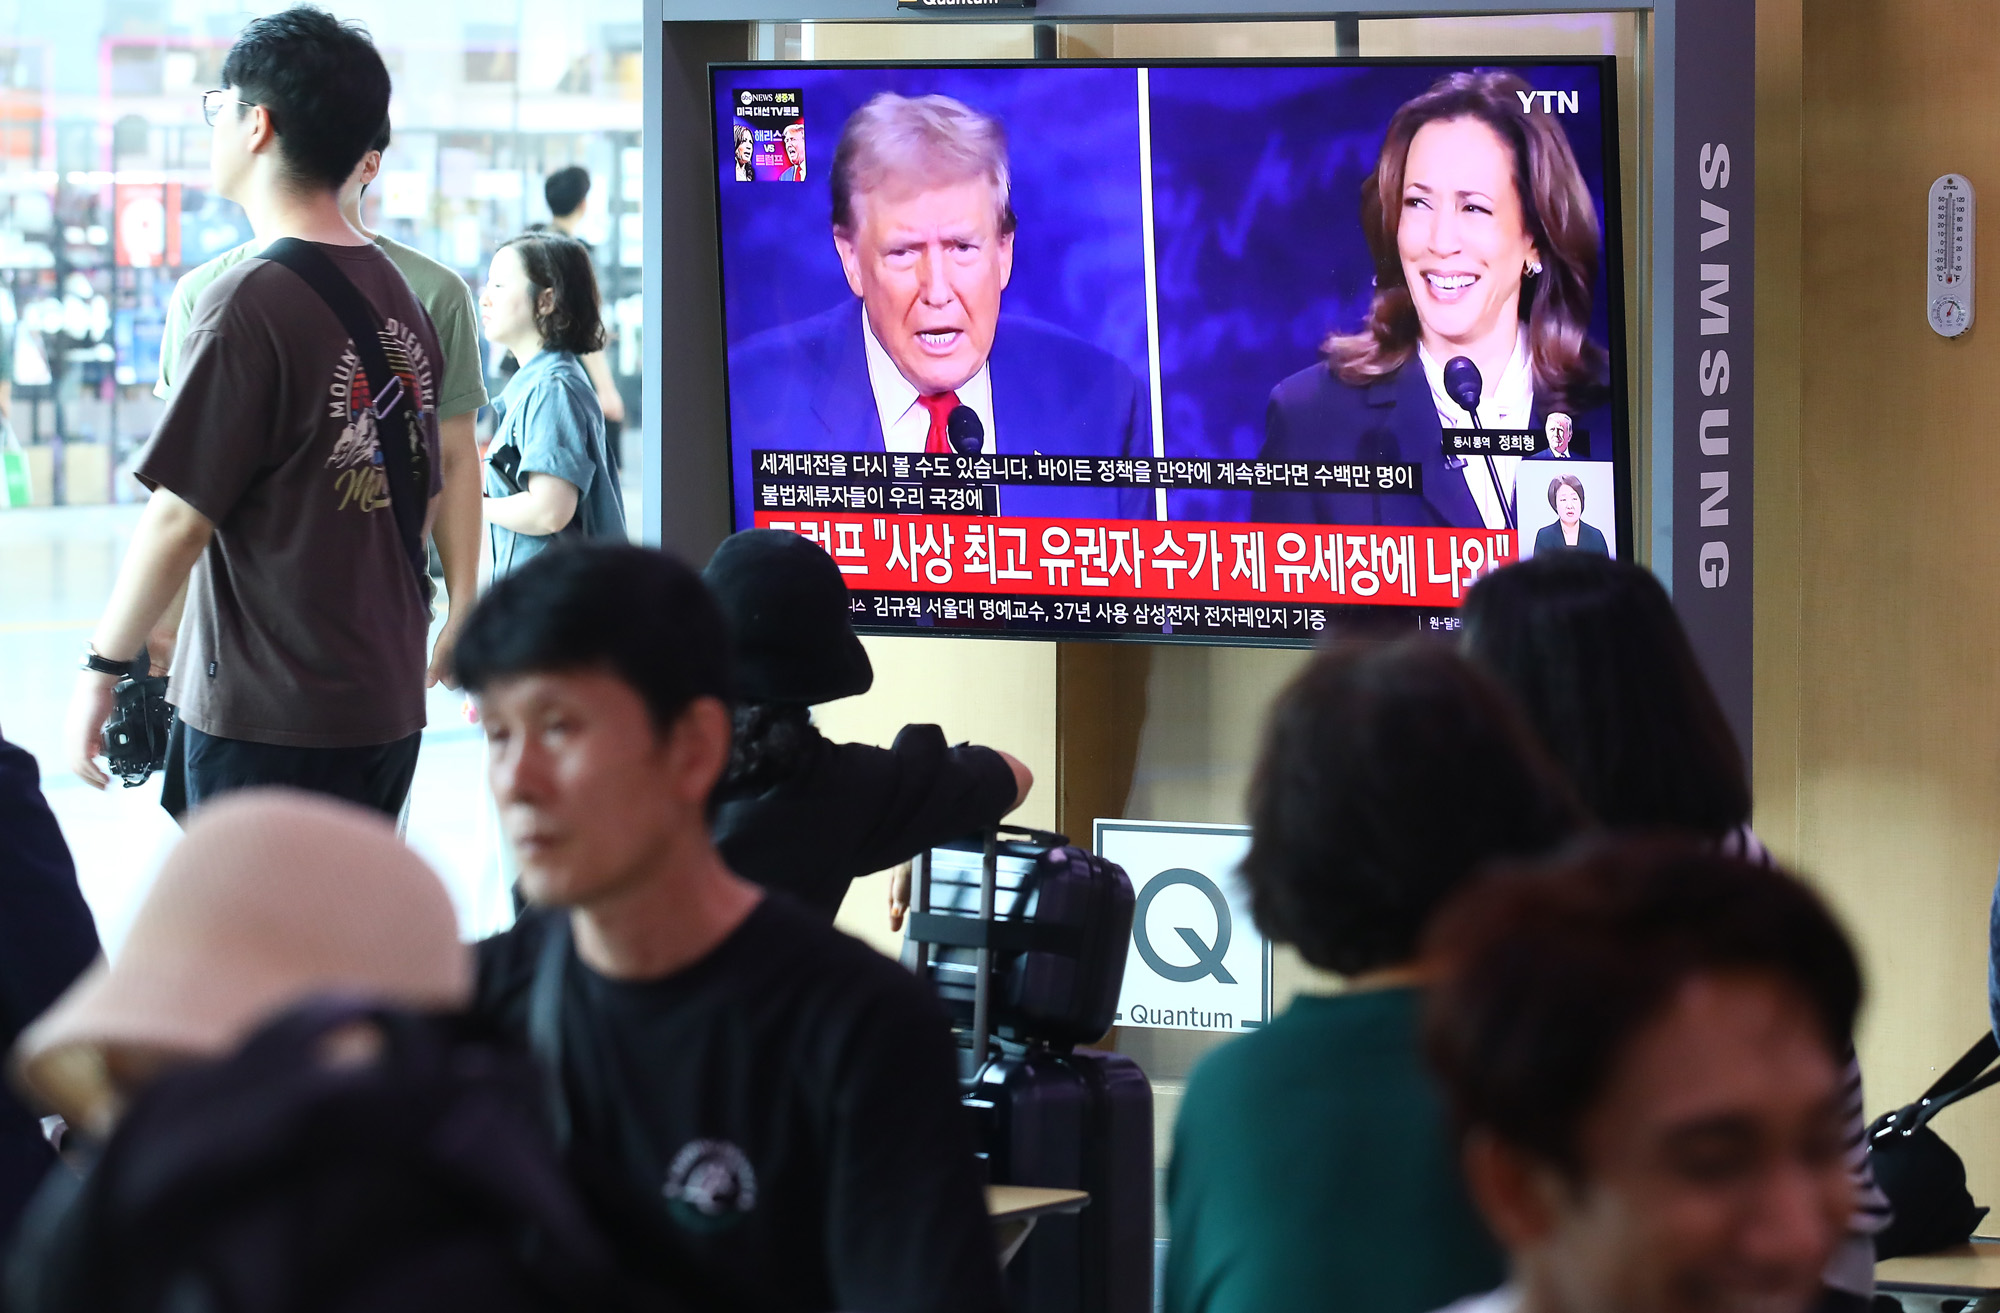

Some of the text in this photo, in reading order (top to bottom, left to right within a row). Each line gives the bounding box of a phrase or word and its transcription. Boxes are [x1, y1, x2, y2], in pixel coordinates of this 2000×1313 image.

[753, 93, 773, 102] NEWS
[775, 92, 795, 103] 생중계
[1515, 90, 1579, 114] YTN
[736, 106, 753, 116] 미국
[753, 106, 770, 116] 대선
[754, 129, 783, 142] 해리스
[755, 154, 783, 166] 트럼프
[1699, 142, 1731, 589] SAMSUNG
[1453, 434, 1536, 451] 동시 통역 정희형
[759, 452, 1414, 489] 세계대전을 다시 볼 수도 있습니다. 바이든 정책을 만약에 계속한다면 수백만 명이
[761, 484, 984, 512] 불법체류자들이 우리 국경에
[872, 517, 956, 585] "사상
[963, 523, 1034, 586] 최고
[1039, 526, 1146, 589] 유권자
[1151, 529, 1224, 591] 수가
[1229, 530, 1268, 593] 제
[1273, 531, 1418, 598] 유세장에
[873, 596, 922, 619] 김규원
[926, 597, 975, 620] 서울대
[979, 598, 1050, 624] 명예교수,
[1053, 601, 1092, 624] 37년
[1095, 602, 1129, 625] 사용
[1132, 603, 1200, 628] 삼성전자
[1204, 605, 1288, 630] 전자레인지
[1292, 607, 1327, 631] 기증
[1132, 867, 1239, 985] Q
[1130, 1004, 1233, 1028] Quantum
